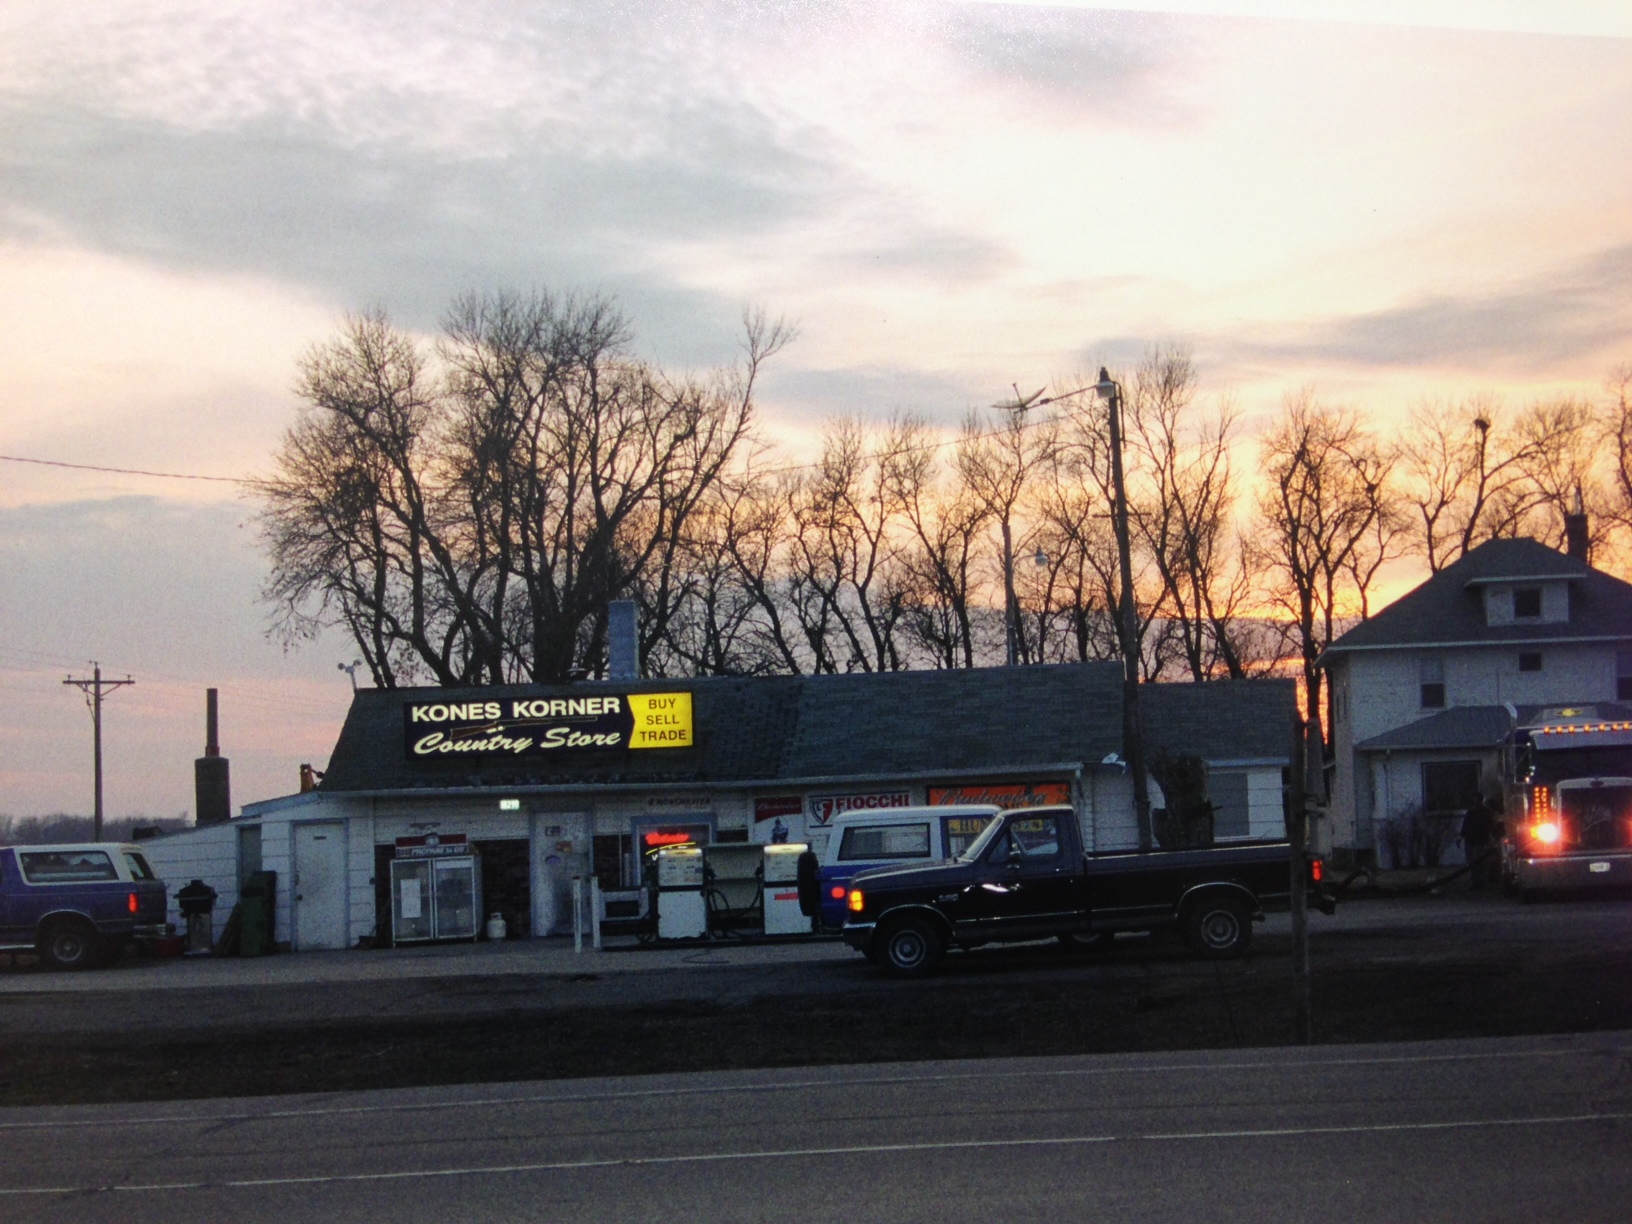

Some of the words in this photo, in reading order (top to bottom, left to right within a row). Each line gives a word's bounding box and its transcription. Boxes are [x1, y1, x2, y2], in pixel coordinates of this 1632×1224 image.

[412, 703, 501, 722] KONES
[513, 697, 621, 718] KORNER
[648, 698, 676, 710] BUY
[646, 715, 680, 726] SELL
[413, 731, 533, 755] Country
[541, 727, 621, 749] Store
[640, 730, 687, 742] TRADE
[835, 794, 910, 810] FIOCCHI
